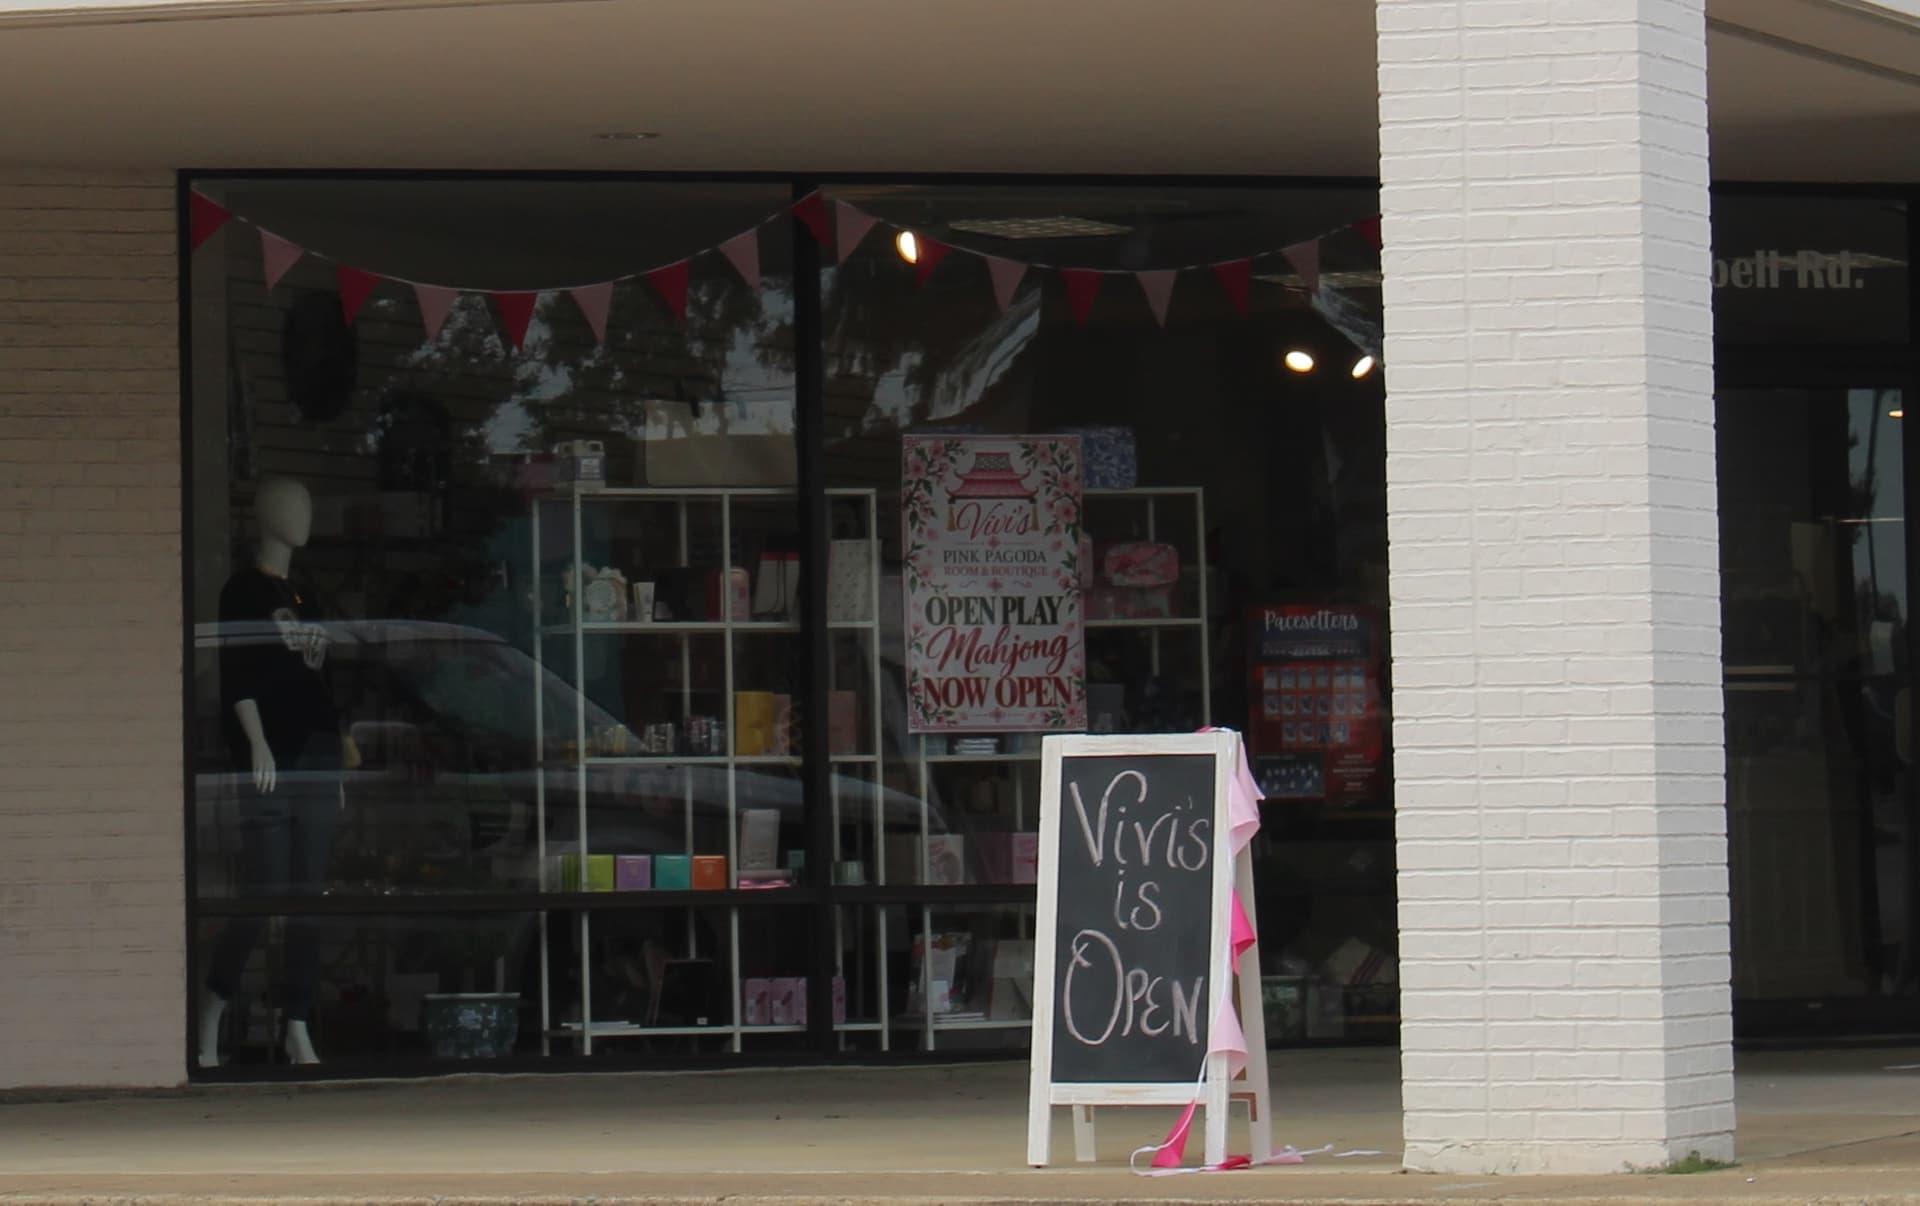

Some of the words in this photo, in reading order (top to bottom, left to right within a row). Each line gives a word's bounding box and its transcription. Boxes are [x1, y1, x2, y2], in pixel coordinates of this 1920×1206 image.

[1797, 250, 1865, 289] Rd.
[956, 502, 1031, 540] Vivi's
[943, 550, 980, 564] PINK
[985, 550, 1047, 564] PAGODA
[944, 566, 979, 577] ROOM
[992, 566, 1048, 577] BOUTIQUE
[925, 596, 996, 626] OPEN
[1001, 596, 1065, 626] PLAY
[1264, 609, 1359, 632] Pacesetters
[926, 624, 1078, 676] Mahjong
[923, 676, 990, 708] NOW
[995, 675, 1073, 708] OPEN
[1069, 770, 1210, 872] Vivi's
[1114, 869, 1162, 931] is
